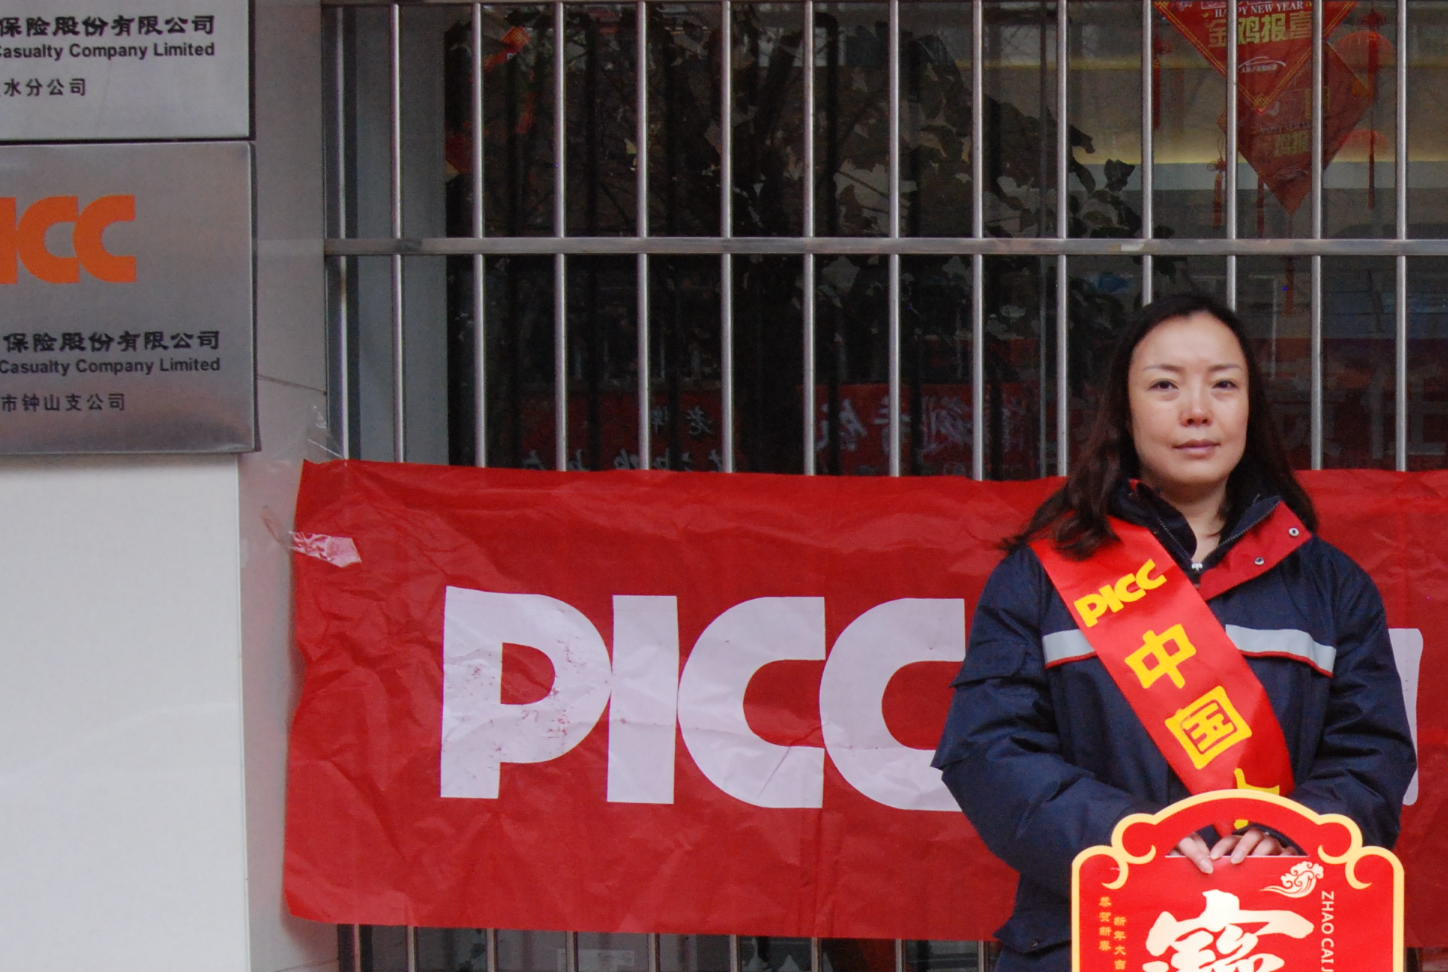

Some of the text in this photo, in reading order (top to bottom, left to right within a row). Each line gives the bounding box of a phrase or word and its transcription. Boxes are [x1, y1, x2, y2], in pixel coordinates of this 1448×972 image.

[1251, 3, 1273, 14] NEW
[1276, 1, 1304, 12] YEAR
[0, 15, 215, 37] 保险股份有限公司
[1208, 11, 1312, 48] 金鸡报喜
[69, 43, 148, 60] Company
[154, 42, 215, 57] Limited
[4, 78, 86, 97] 水分公司
[3, 331, 219, 353] 保险股份有限公司
[0, 357, 221, 376] Casualty Company Limited
[1074, 559, 1167, 628] PICC
[440, 586, 965, 812] PICC
[1321, 890, 1335, 935] ZHAO
[1321, 937, 1335, 964] CAI
